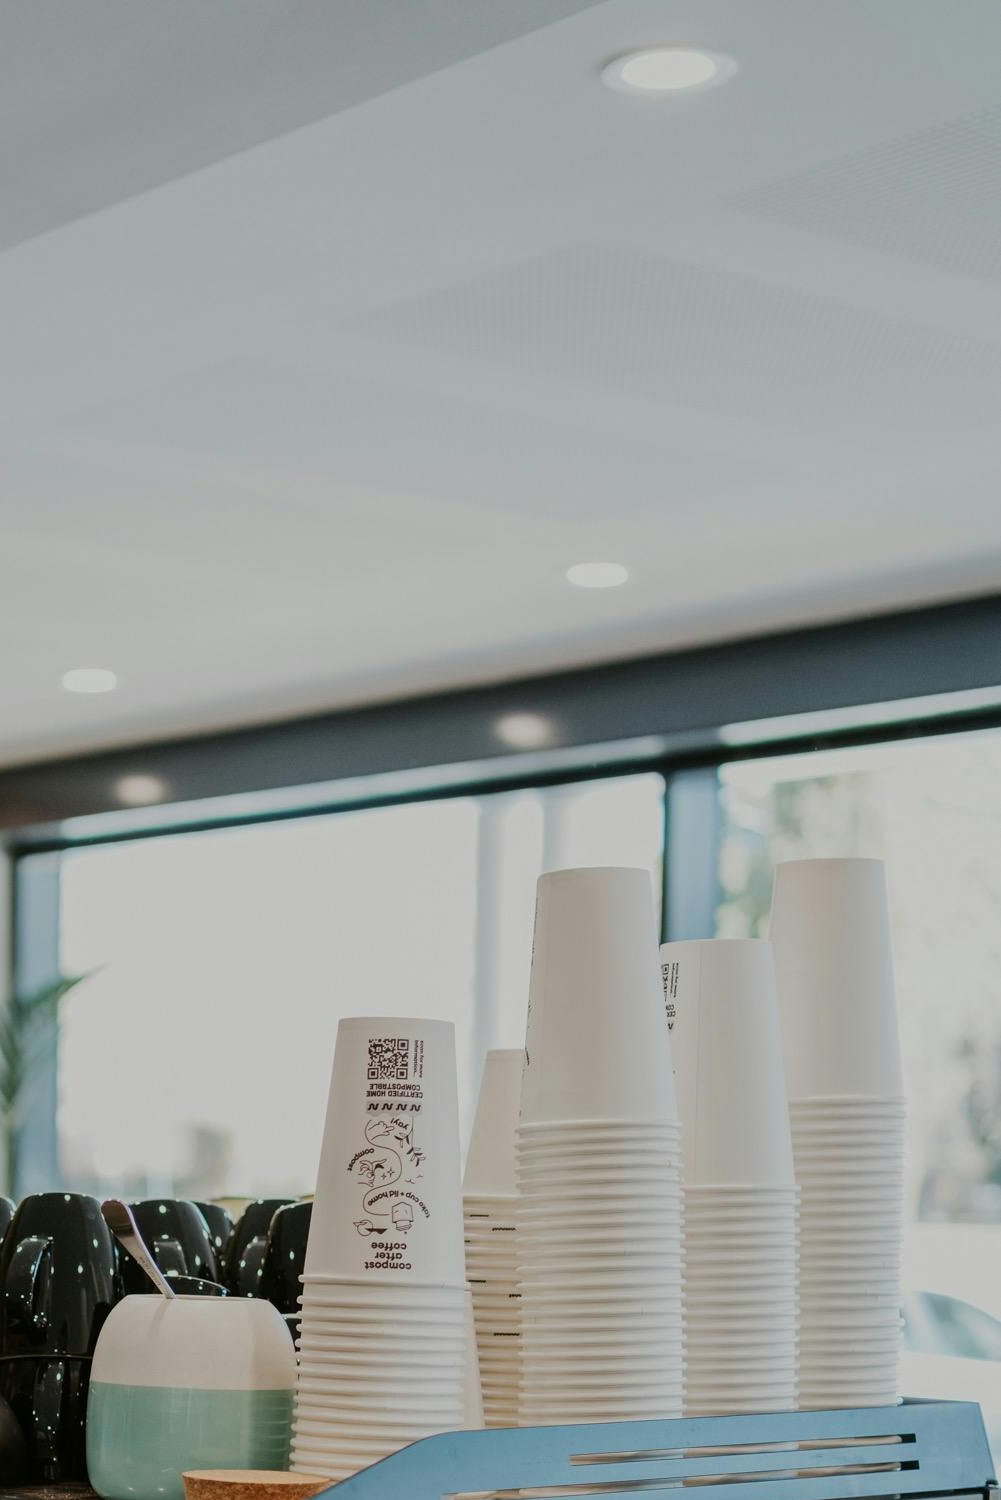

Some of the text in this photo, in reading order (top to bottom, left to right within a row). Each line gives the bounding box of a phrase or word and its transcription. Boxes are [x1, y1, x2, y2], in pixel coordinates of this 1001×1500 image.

[369, 1083, 421, 1091] COMPOSTABLE
[366, 1090, 424, 1098] CERTIFIED HOME
[390, 1117, 409, 1130] yay!
[347, 1147, 375, 1171] compost
[367, 1191, 389, 1207] home
[388, 1190, 399, 1198] lid
[405, 1191, 420, 1204] cup
[419, 1201, 431, 1219] take
[370, 1242, 407, 1251] coffee
[374, 1251, 403, 1261] after
[364, 1260, 412, 1270] compost
